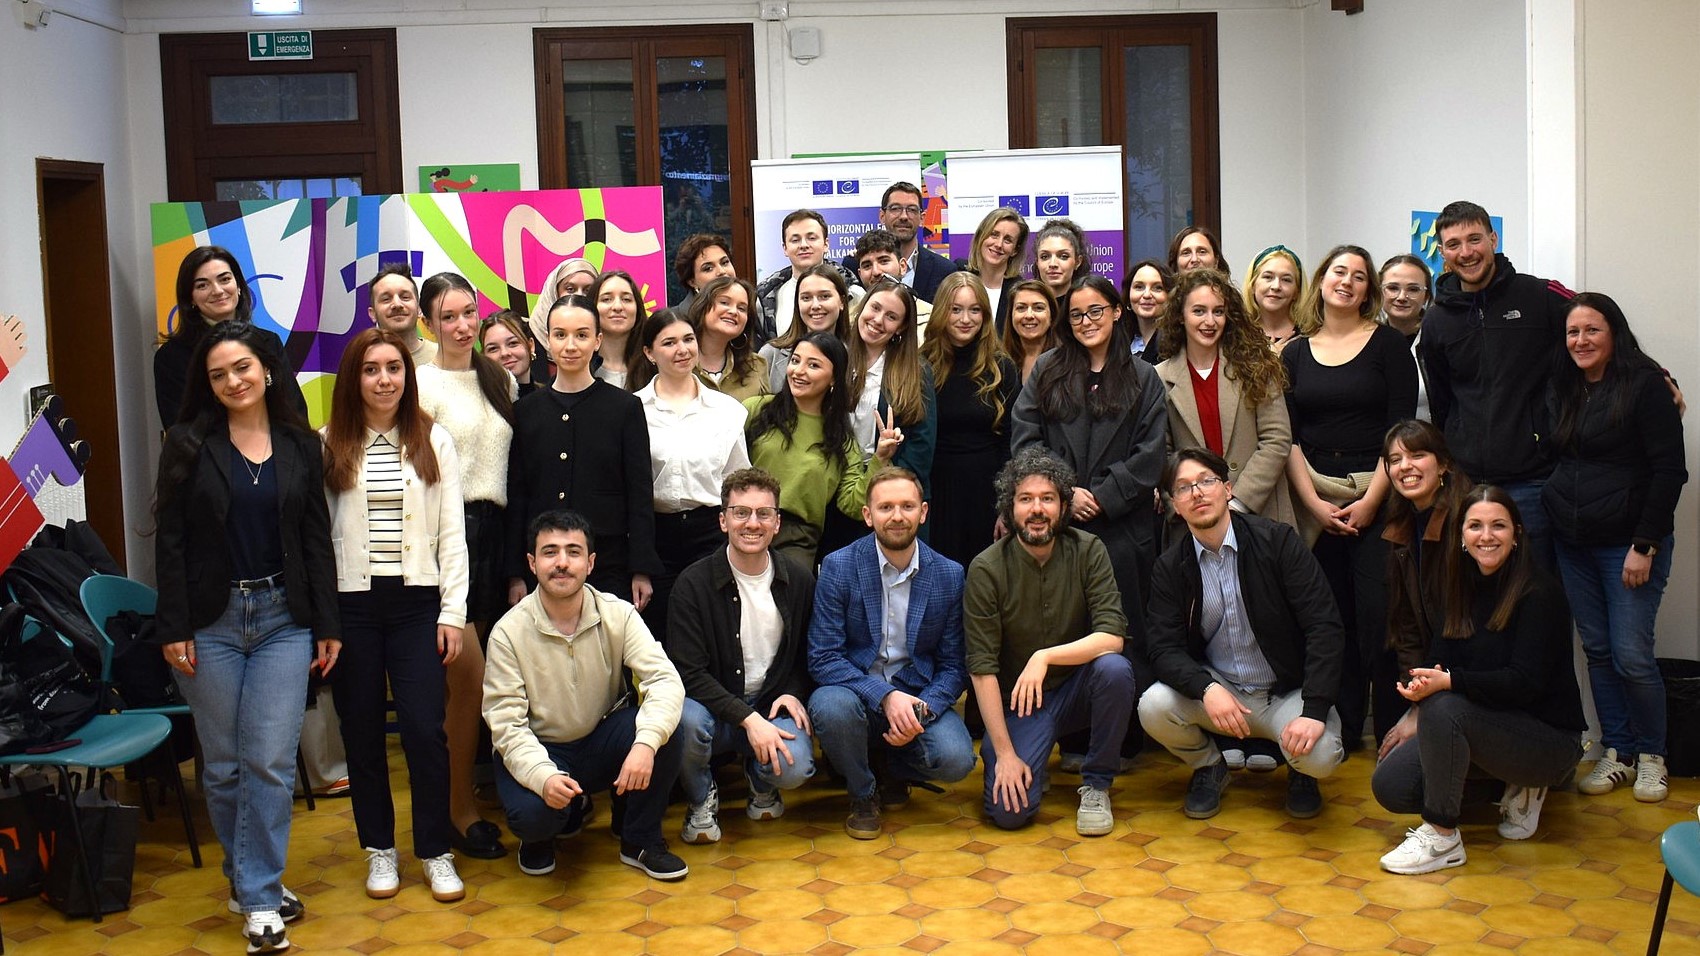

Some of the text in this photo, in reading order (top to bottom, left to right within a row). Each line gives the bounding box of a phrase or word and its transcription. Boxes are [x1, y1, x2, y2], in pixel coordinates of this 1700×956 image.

[276, 35, 308, 43] USCITA DI
[276, 45, 310, 53] EMERGENZA
[839, 236, 855, 246] FOR
